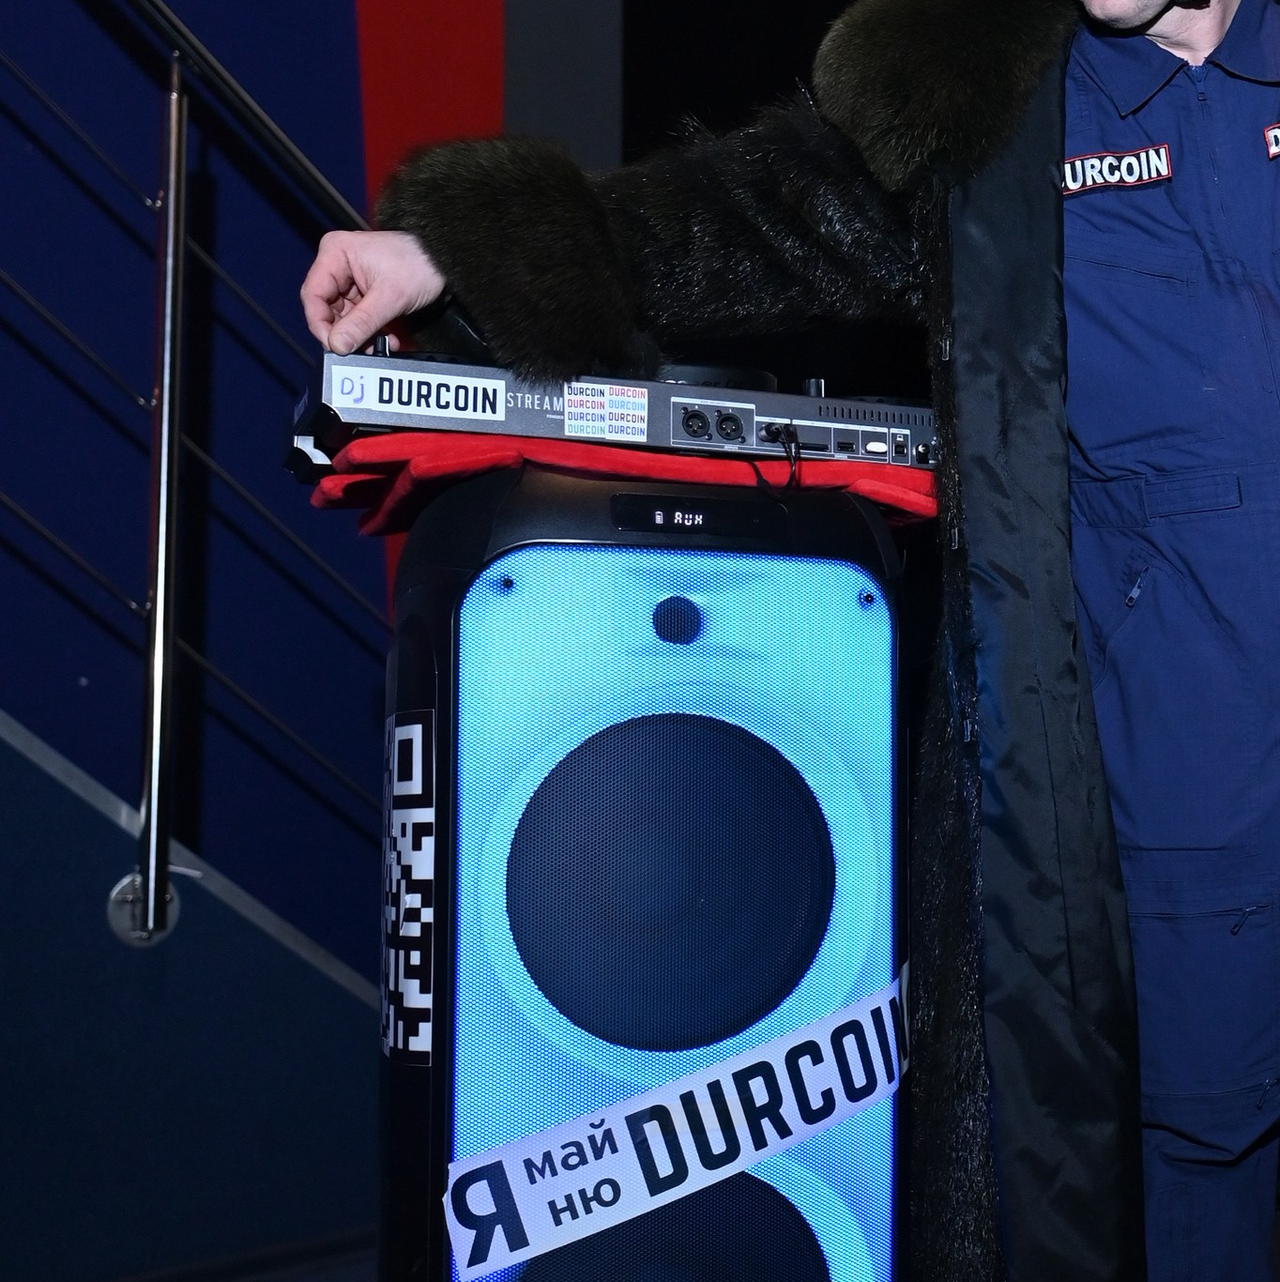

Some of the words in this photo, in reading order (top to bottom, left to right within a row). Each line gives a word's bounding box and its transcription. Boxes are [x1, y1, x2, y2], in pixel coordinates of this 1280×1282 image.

[1061, 147, 1168, 191] URCOIN
[340, 375, 365, 404] Dj
[378, 376, 498, 415] DURCOIN
[567, 386, 606, 398] DURCOIN
[608, 387, 646, 399] DURCOIN
[507, 392, 564, 412] STREAM
[567, 399, 606, 410] DURCOIN
[608, 399, 646, 411] DURCOIN
[567, 411, 606, 422] DURCOIN
[608, 411, 646, 424] DURCOIN
[567, 424, 606, 436] DURCOIN
[608, 424, 646, 436] DURCOIN
[674, 511, 703, 526] AUX
[624, 981, 910, 1198] DURCOIN
[522, 1117, 621, 1186] май
[547, 1176, 622, 1228] ню
[450, 1160, 531, 1268] Я
